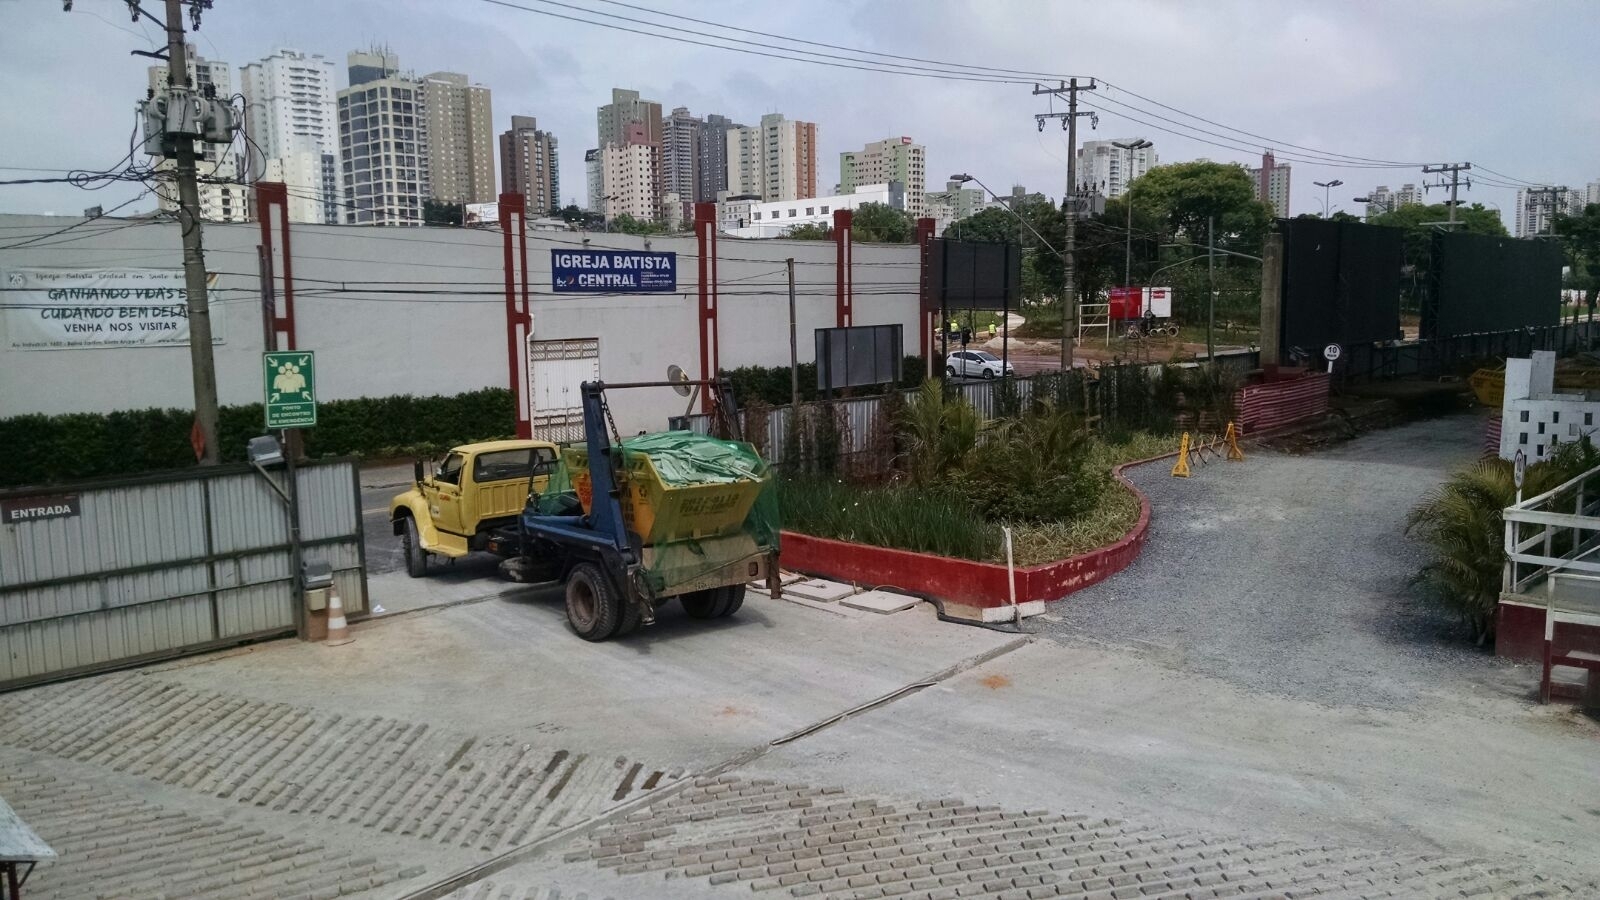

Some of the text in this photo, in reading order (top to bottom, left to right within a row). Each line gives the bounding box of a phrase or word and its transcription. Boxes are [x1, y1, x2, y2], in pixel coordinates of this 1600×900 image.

[555, 254, 671, 270] IGREJA BATISTA
[578, 273, 637, 287] CENTRAL
[48, 288, 131, 301] GANHANDO
[41, 304, 189, 320] CUIDANDO BEM DELA
[64, 321, 177, 333] VENHA NOS VISITAR
[1328, 346, 1338, 354] 10
[11, 505, 72, 519] ENTRADA
